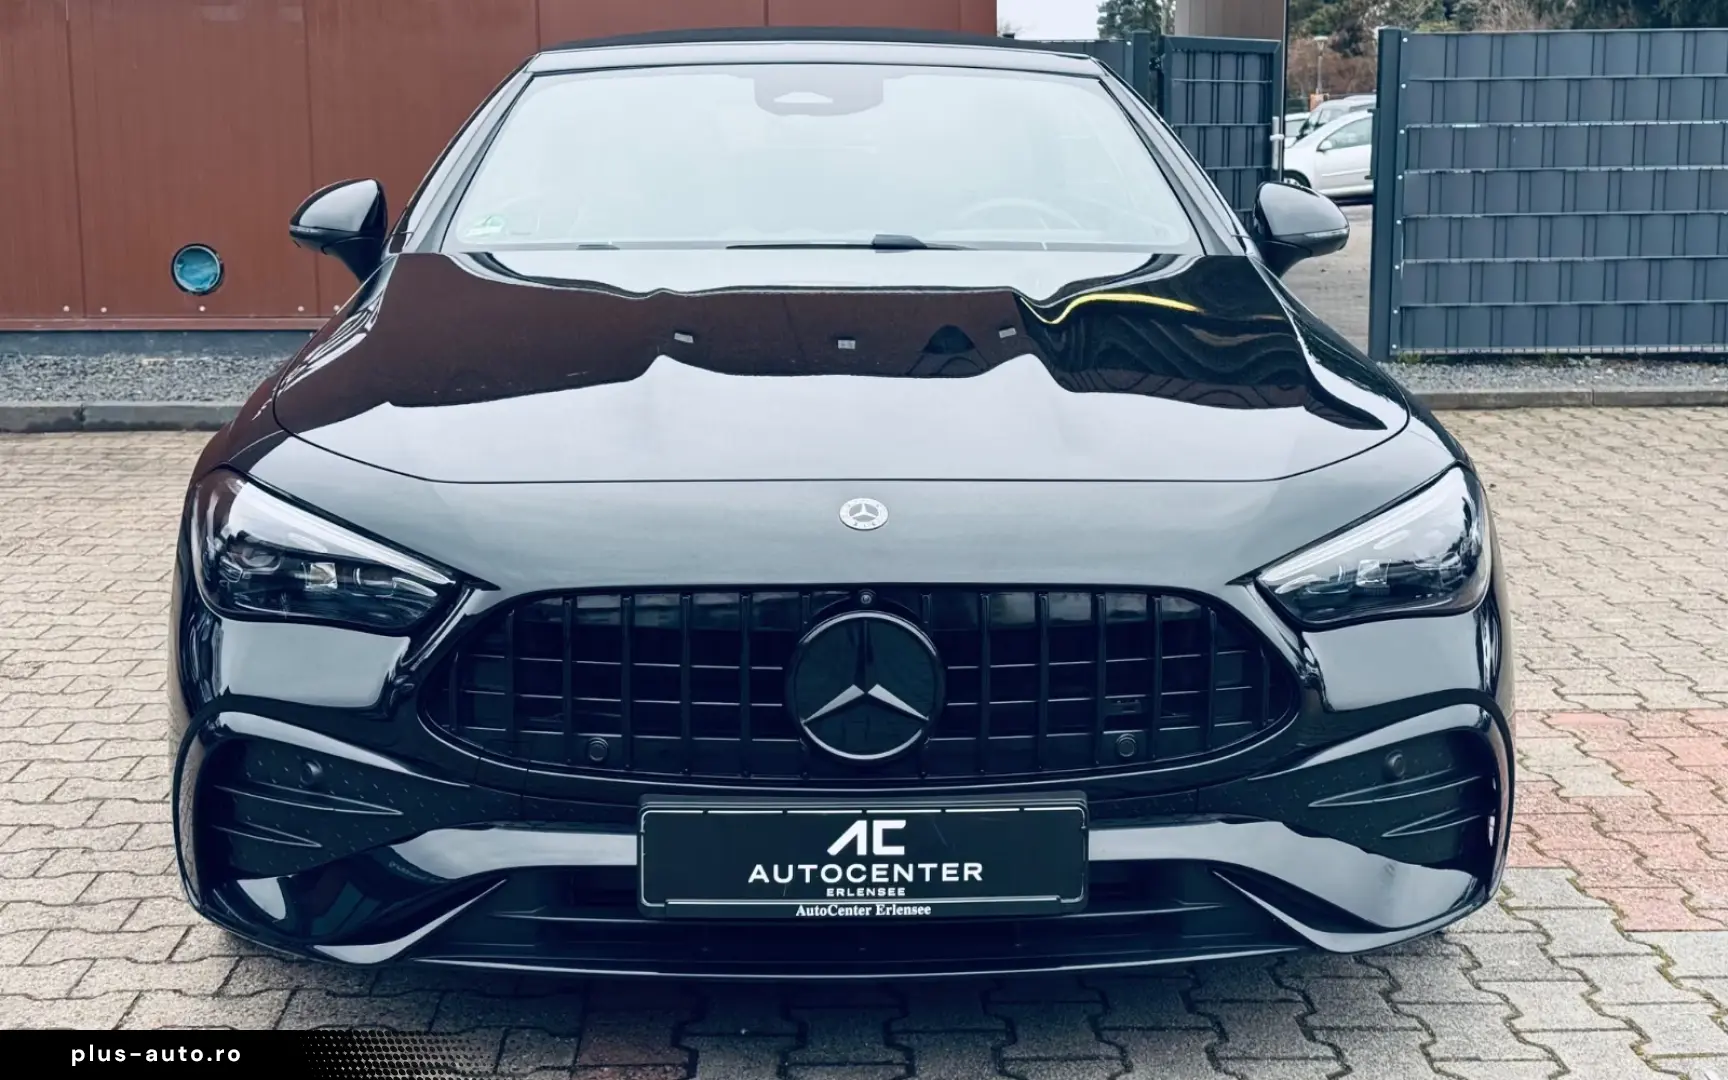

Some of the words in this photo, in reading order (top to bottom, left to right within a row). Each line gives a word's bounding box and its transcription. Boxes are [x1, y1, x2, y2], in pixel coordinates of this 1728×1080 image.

[827, 819, 907, 856] AC
[747, 862, 983, 884] AUTOCENTER
[826, 887, 906, 897] ERLENSEE
[796, 904, 872, 917] AutoCenter
[875, 903, 932, 916] Erlensee
